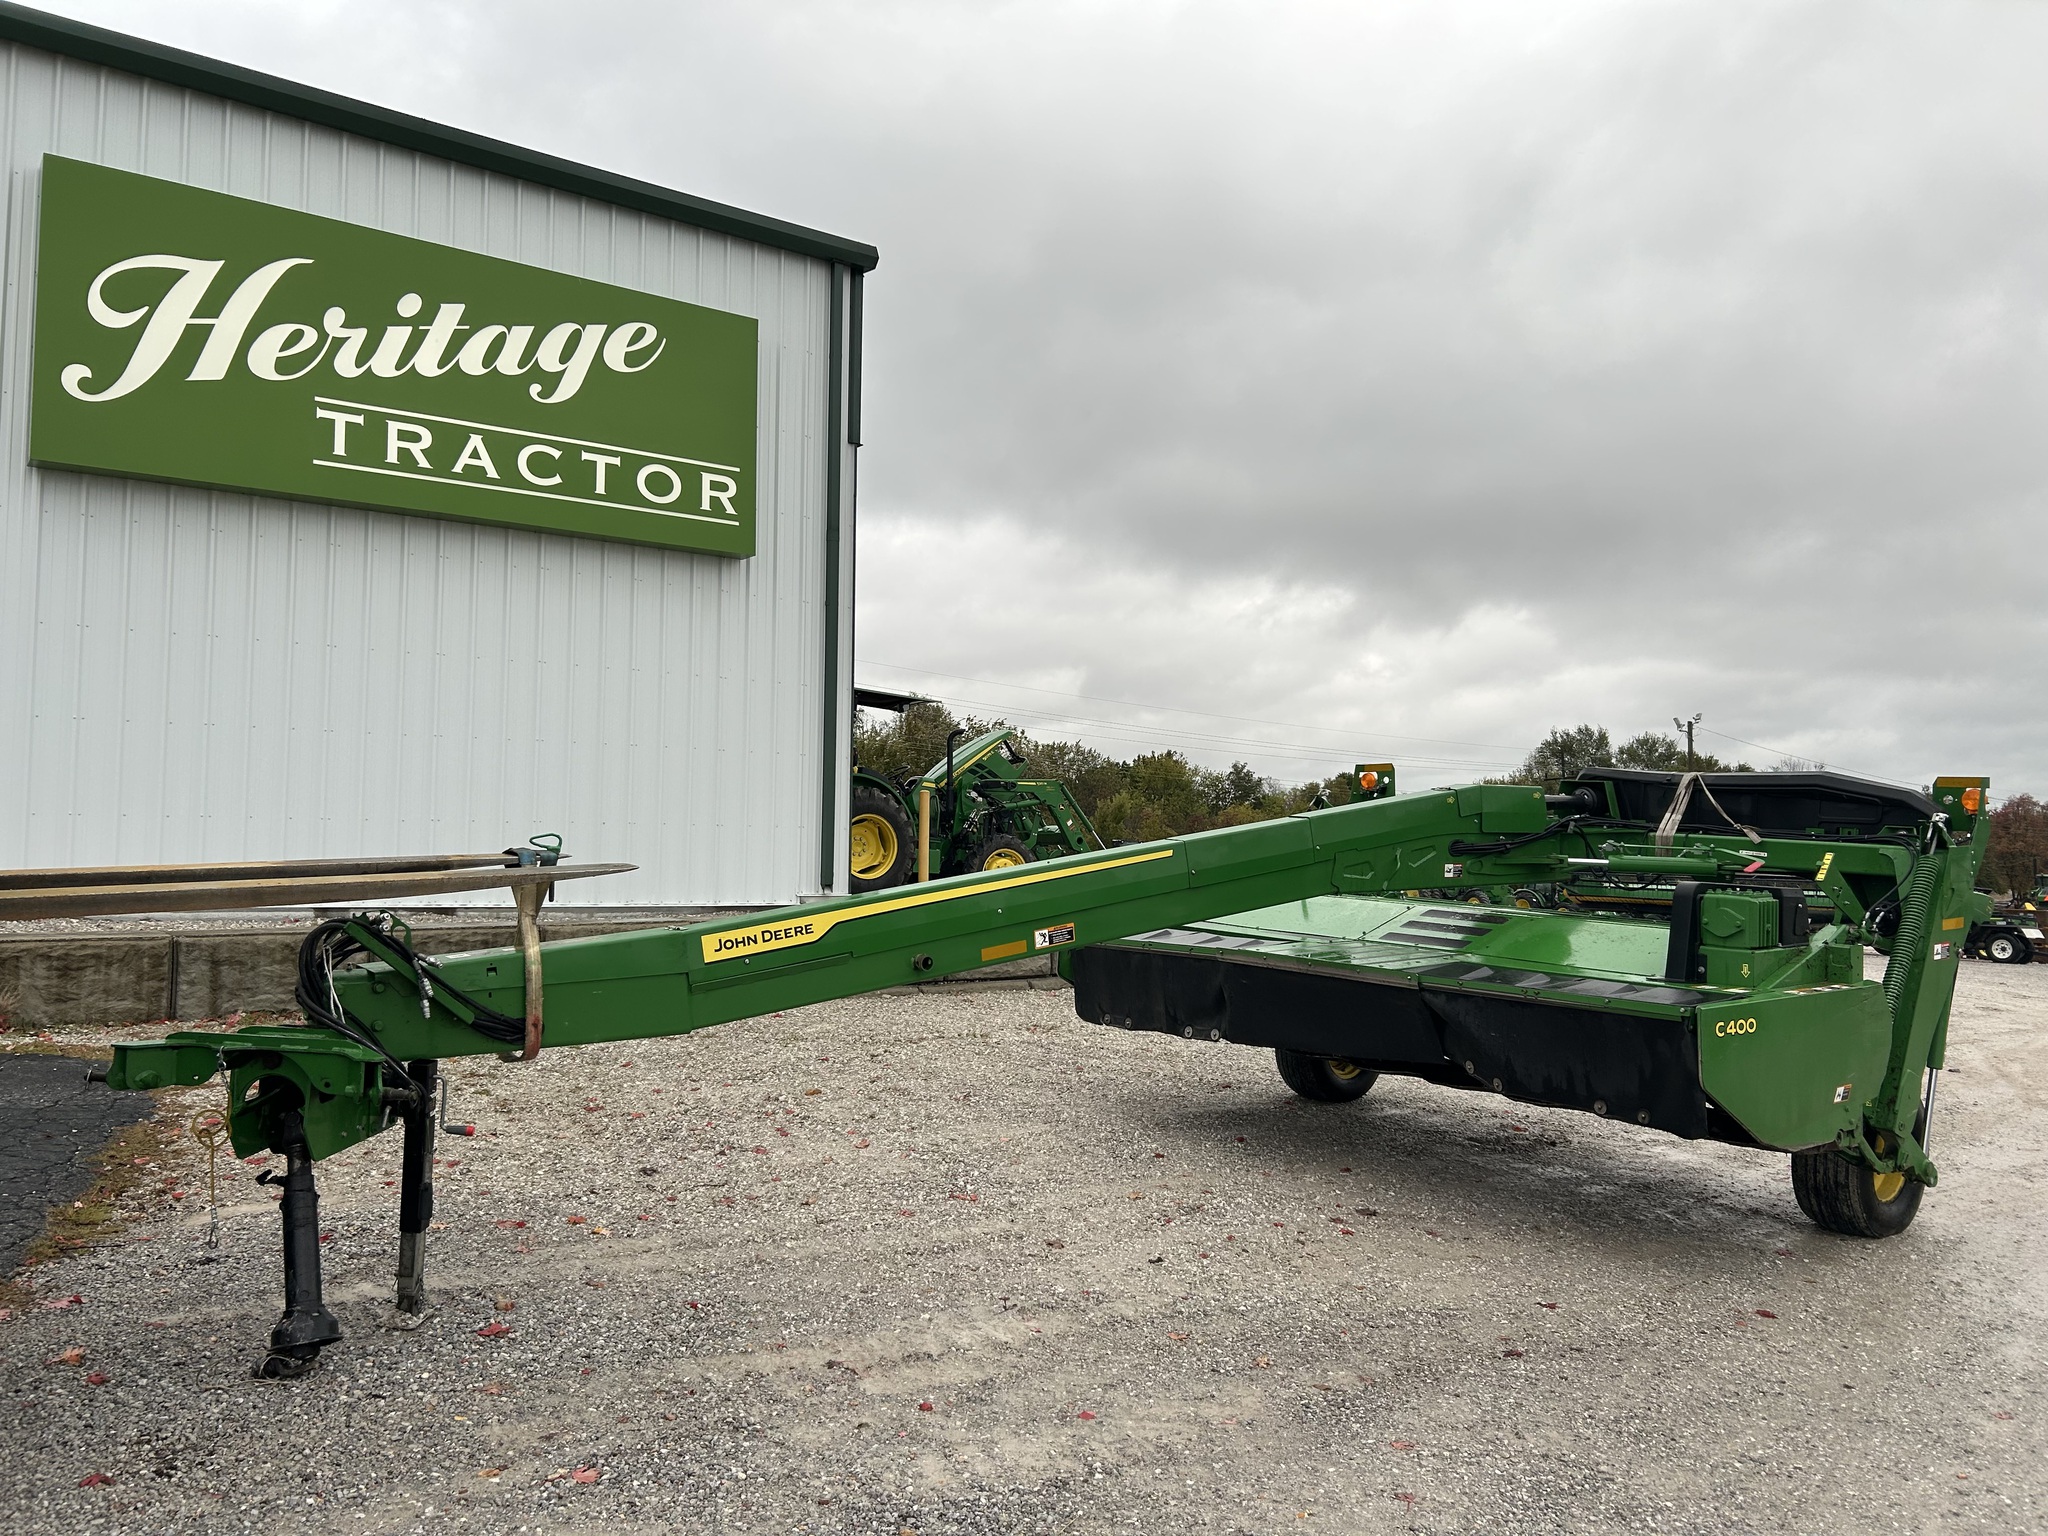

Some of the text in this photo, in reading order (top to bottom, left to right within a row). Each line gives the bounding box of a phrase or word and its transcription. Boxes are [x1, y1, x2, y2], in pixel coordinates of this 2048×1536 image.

[60, 253, 667, 404] Heritage
[314, 406, 739, 516] TRACTOR
[714, 923, 814, 953] JOHN DEERE
[1715, 1017, 1757, 1038] C400
